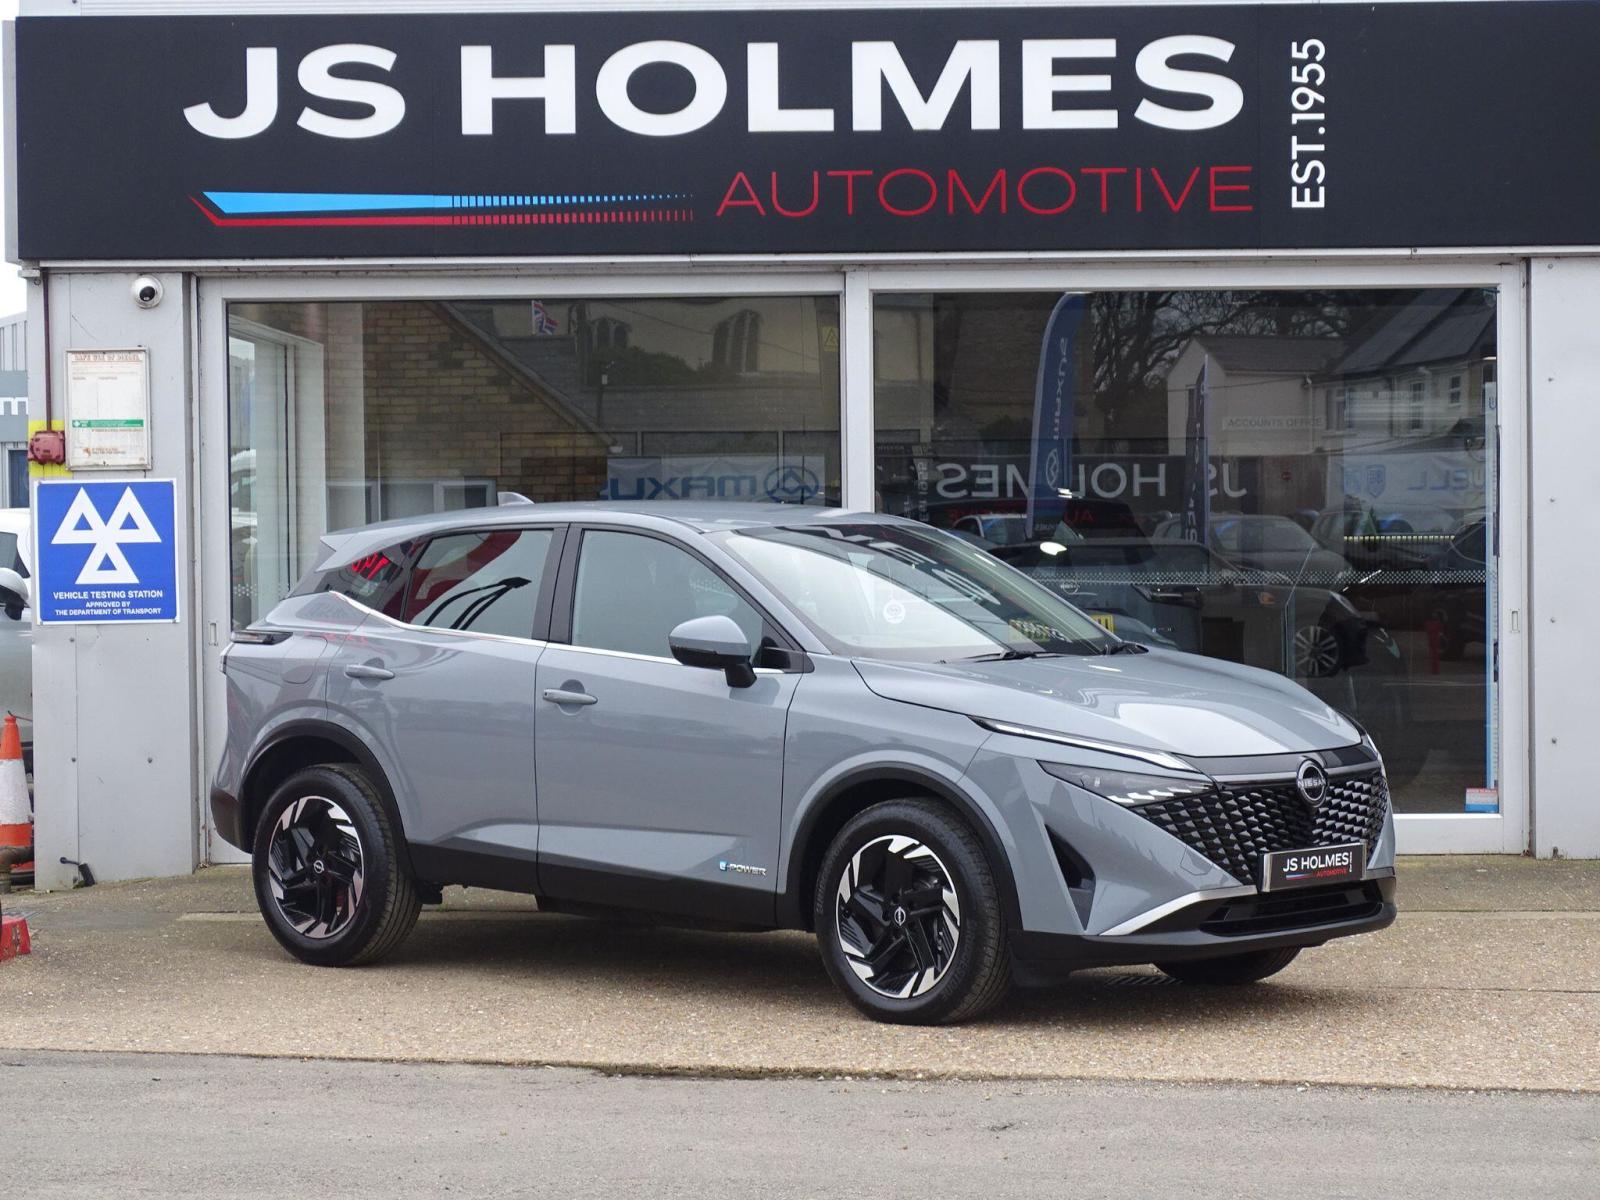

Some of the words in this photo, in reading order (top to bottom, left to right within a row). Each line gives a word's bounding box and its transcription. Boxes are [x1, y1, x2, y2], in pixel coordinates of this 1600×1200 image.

[183, 43, 407, 140] JS
[460, 34, 1245, 137] HOLMES
[1291, 38, 1326, 209] EST.1955
[716, 165, 1254, 217] AUTOMOTIVE
[53, 591, 89, 599] VEHICLE
[90, 591, 126, 599] TESTING
[127, 590, 163, 598] STATION
[1282, 858, 1299, 872] JS
[1301, 852, 1349, 870] HOLMES
